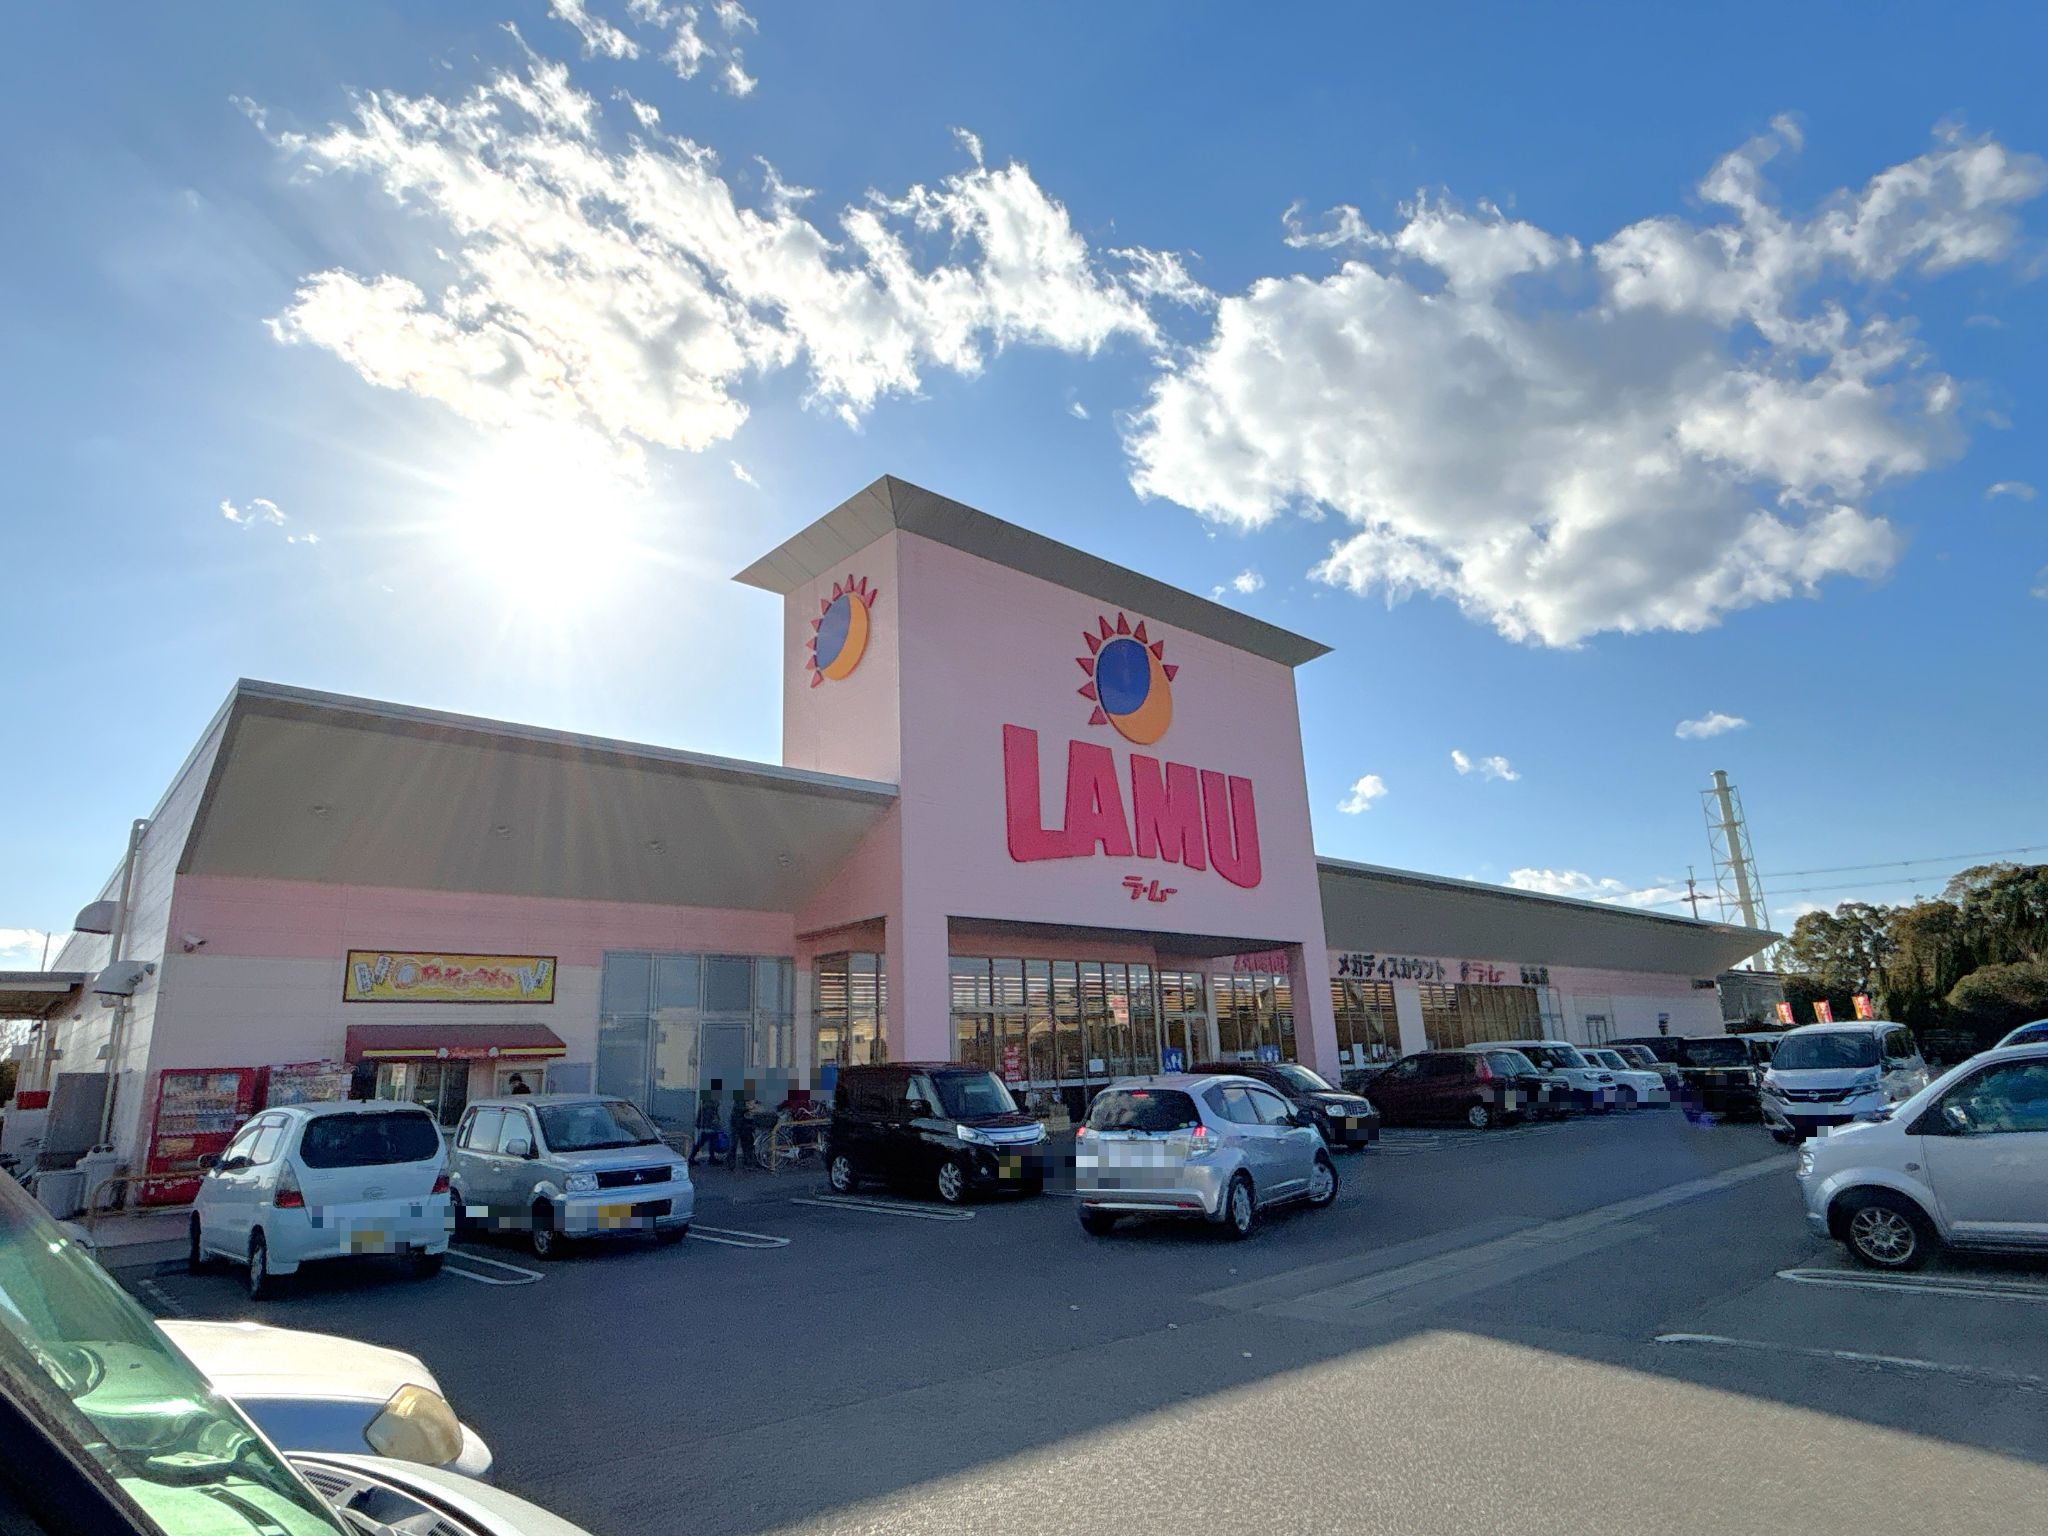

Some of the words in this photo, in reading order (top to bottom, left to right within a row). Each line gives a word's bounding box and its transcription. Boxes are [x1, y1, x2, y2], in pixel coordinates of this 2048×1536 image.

[1002, 723, 1262, 889] LAMU
[1338, 953, 1446, 981] メガディスカウント
